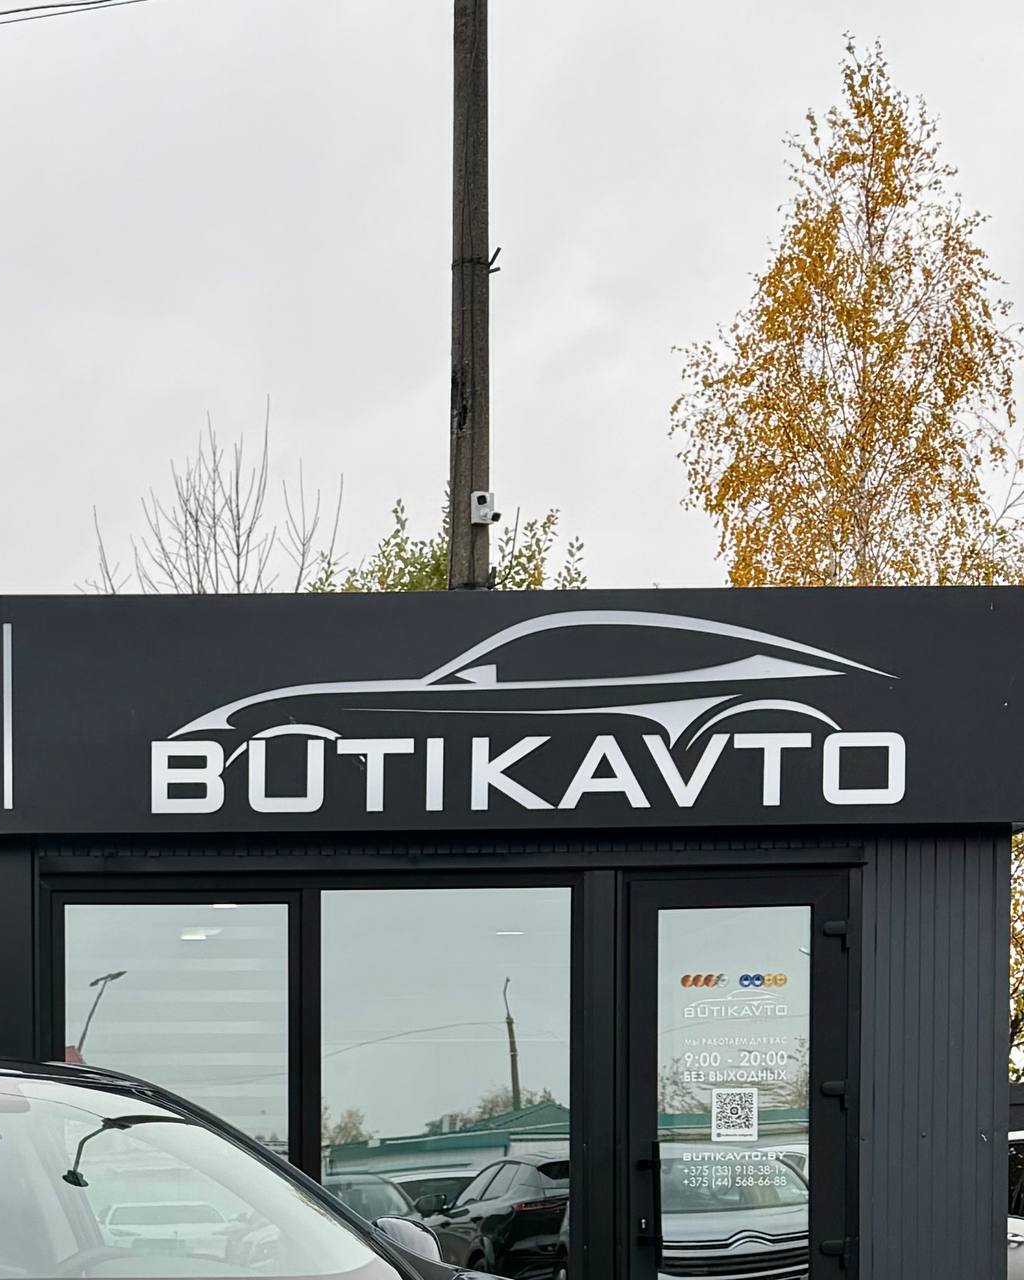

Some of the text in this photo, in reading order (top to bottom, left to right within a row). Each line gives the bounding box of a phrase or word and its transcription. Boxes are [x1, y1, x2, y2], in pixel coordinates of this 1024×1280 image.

[150, 732, 907, 815] BUTIKAVTO
[684, 1004, 788, 1018] BUTIKAVTO
[684, 1051, 721, 1067] 9:00
[739, 1050, 788, 1066] 20:00
[684, 1069, 787, 1082] БЕЗ ВЫХОДНЫХ
[682, 1151, 787, 1161] BUTIKAVTO.BY
[683, 1165, 787, 1177] +375 (33) 918-38-19
[683, 1176, 788, 1189] +375 (44) 568-66-88
